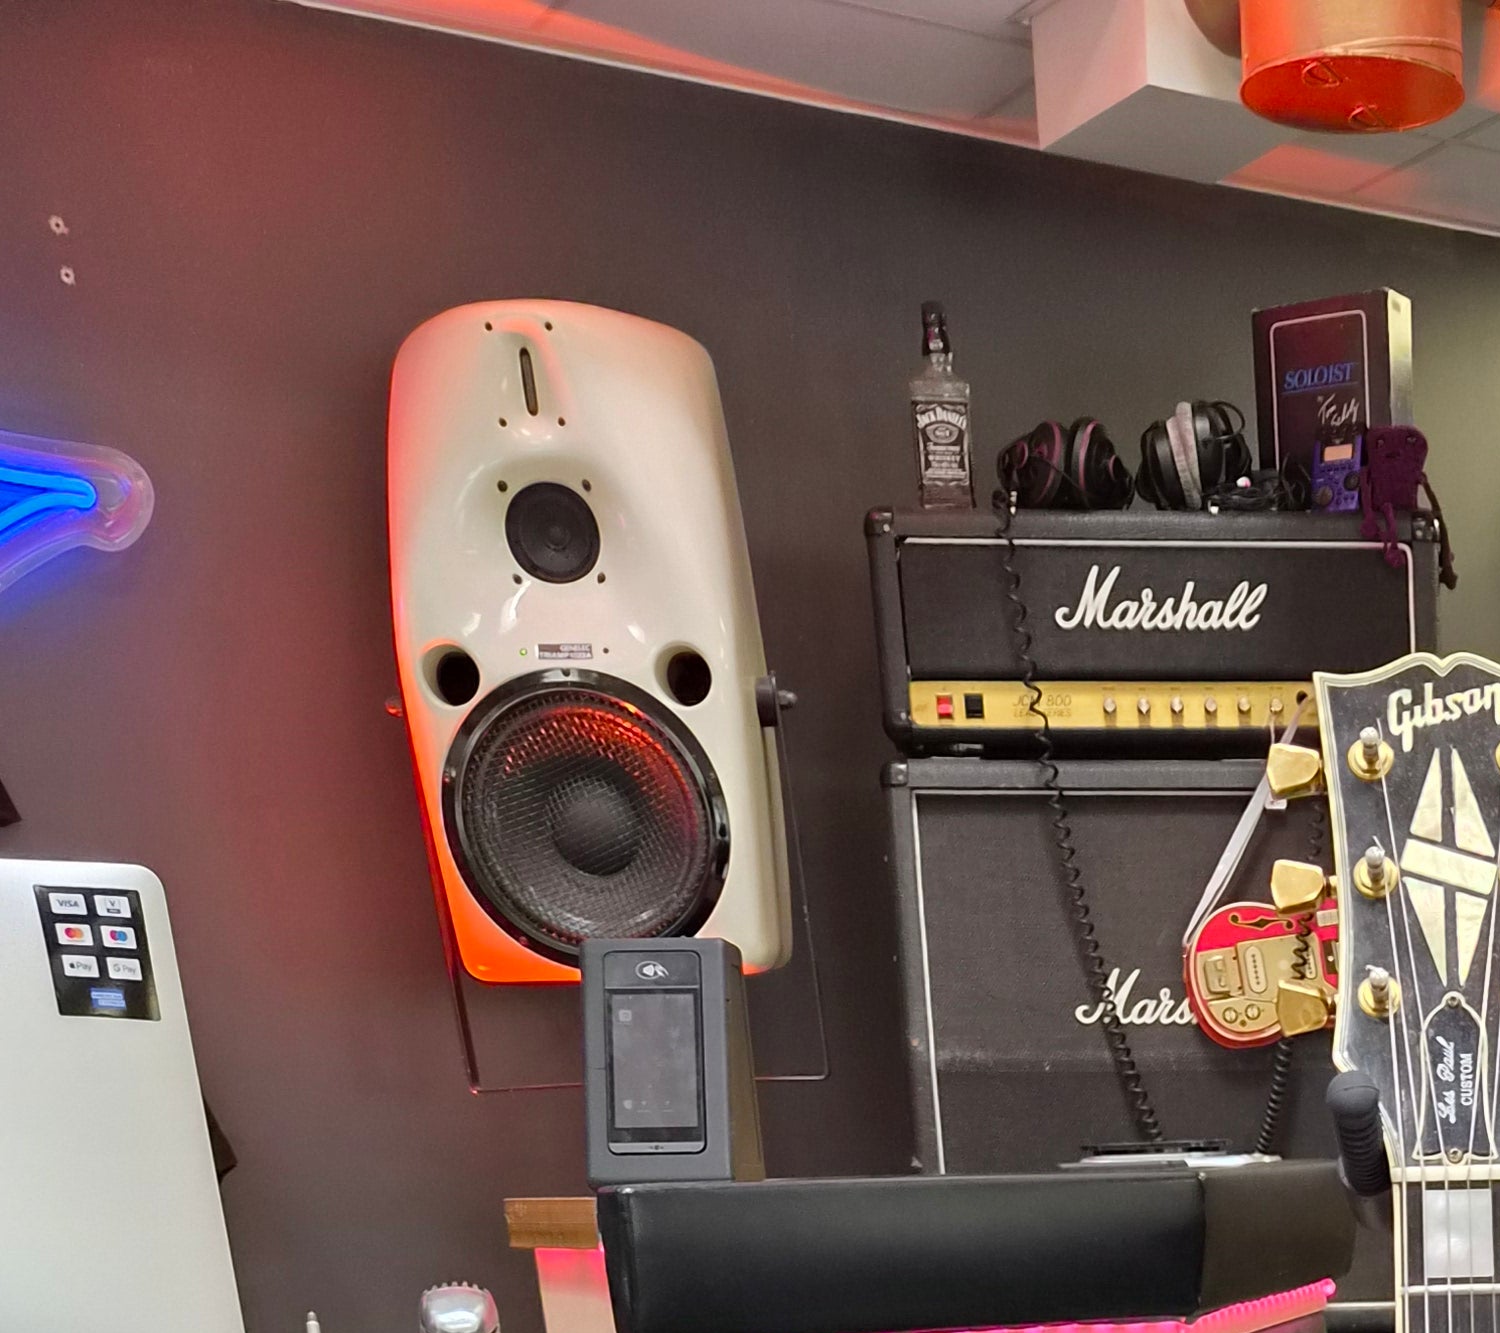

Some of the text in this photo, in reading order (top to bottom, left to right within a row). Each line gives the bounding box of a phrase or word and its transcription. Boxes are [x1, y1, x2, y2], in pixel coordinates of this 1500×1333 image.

[1284, 362, 1355, 390] SOLOIST
[1054, 564, 1268, 631] Marshall
[1046, 695, 1072, 707] 800
[56, 899, 79, 908] VISA
[1074, 968, 1199, 1025] Mars
[1435, 1036, 1456, 1124] Les Paul
[1459, 1053, 1473, 1106] CUSTOM
